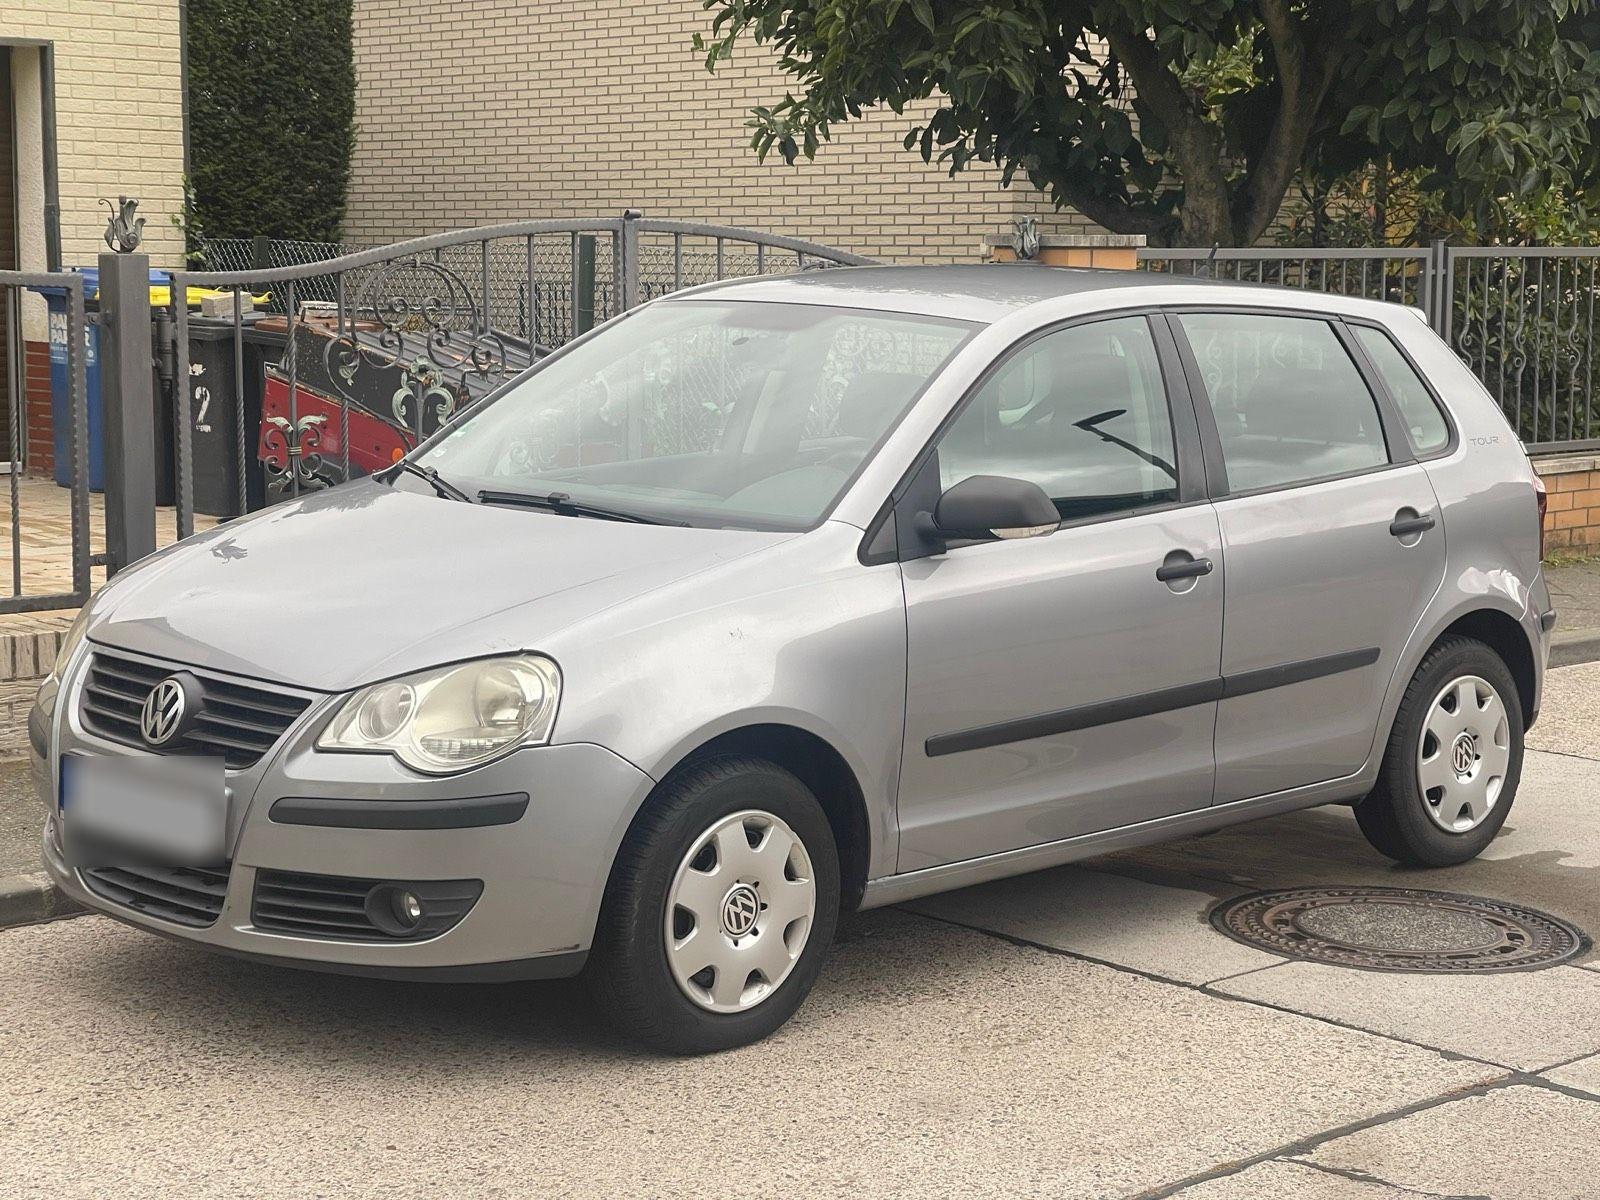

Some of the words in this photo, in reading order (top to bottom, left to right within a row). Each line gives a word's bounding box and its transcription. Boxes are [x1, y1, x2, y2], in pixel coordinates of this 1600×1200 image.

[195, 386, 212, 433] 2
[1469, 436, 1499, 446] TOUR
[141, 679, 185, 745] VW
[1453, 735, 1475, 773] VW
[723, 887, 758, 935] VW
